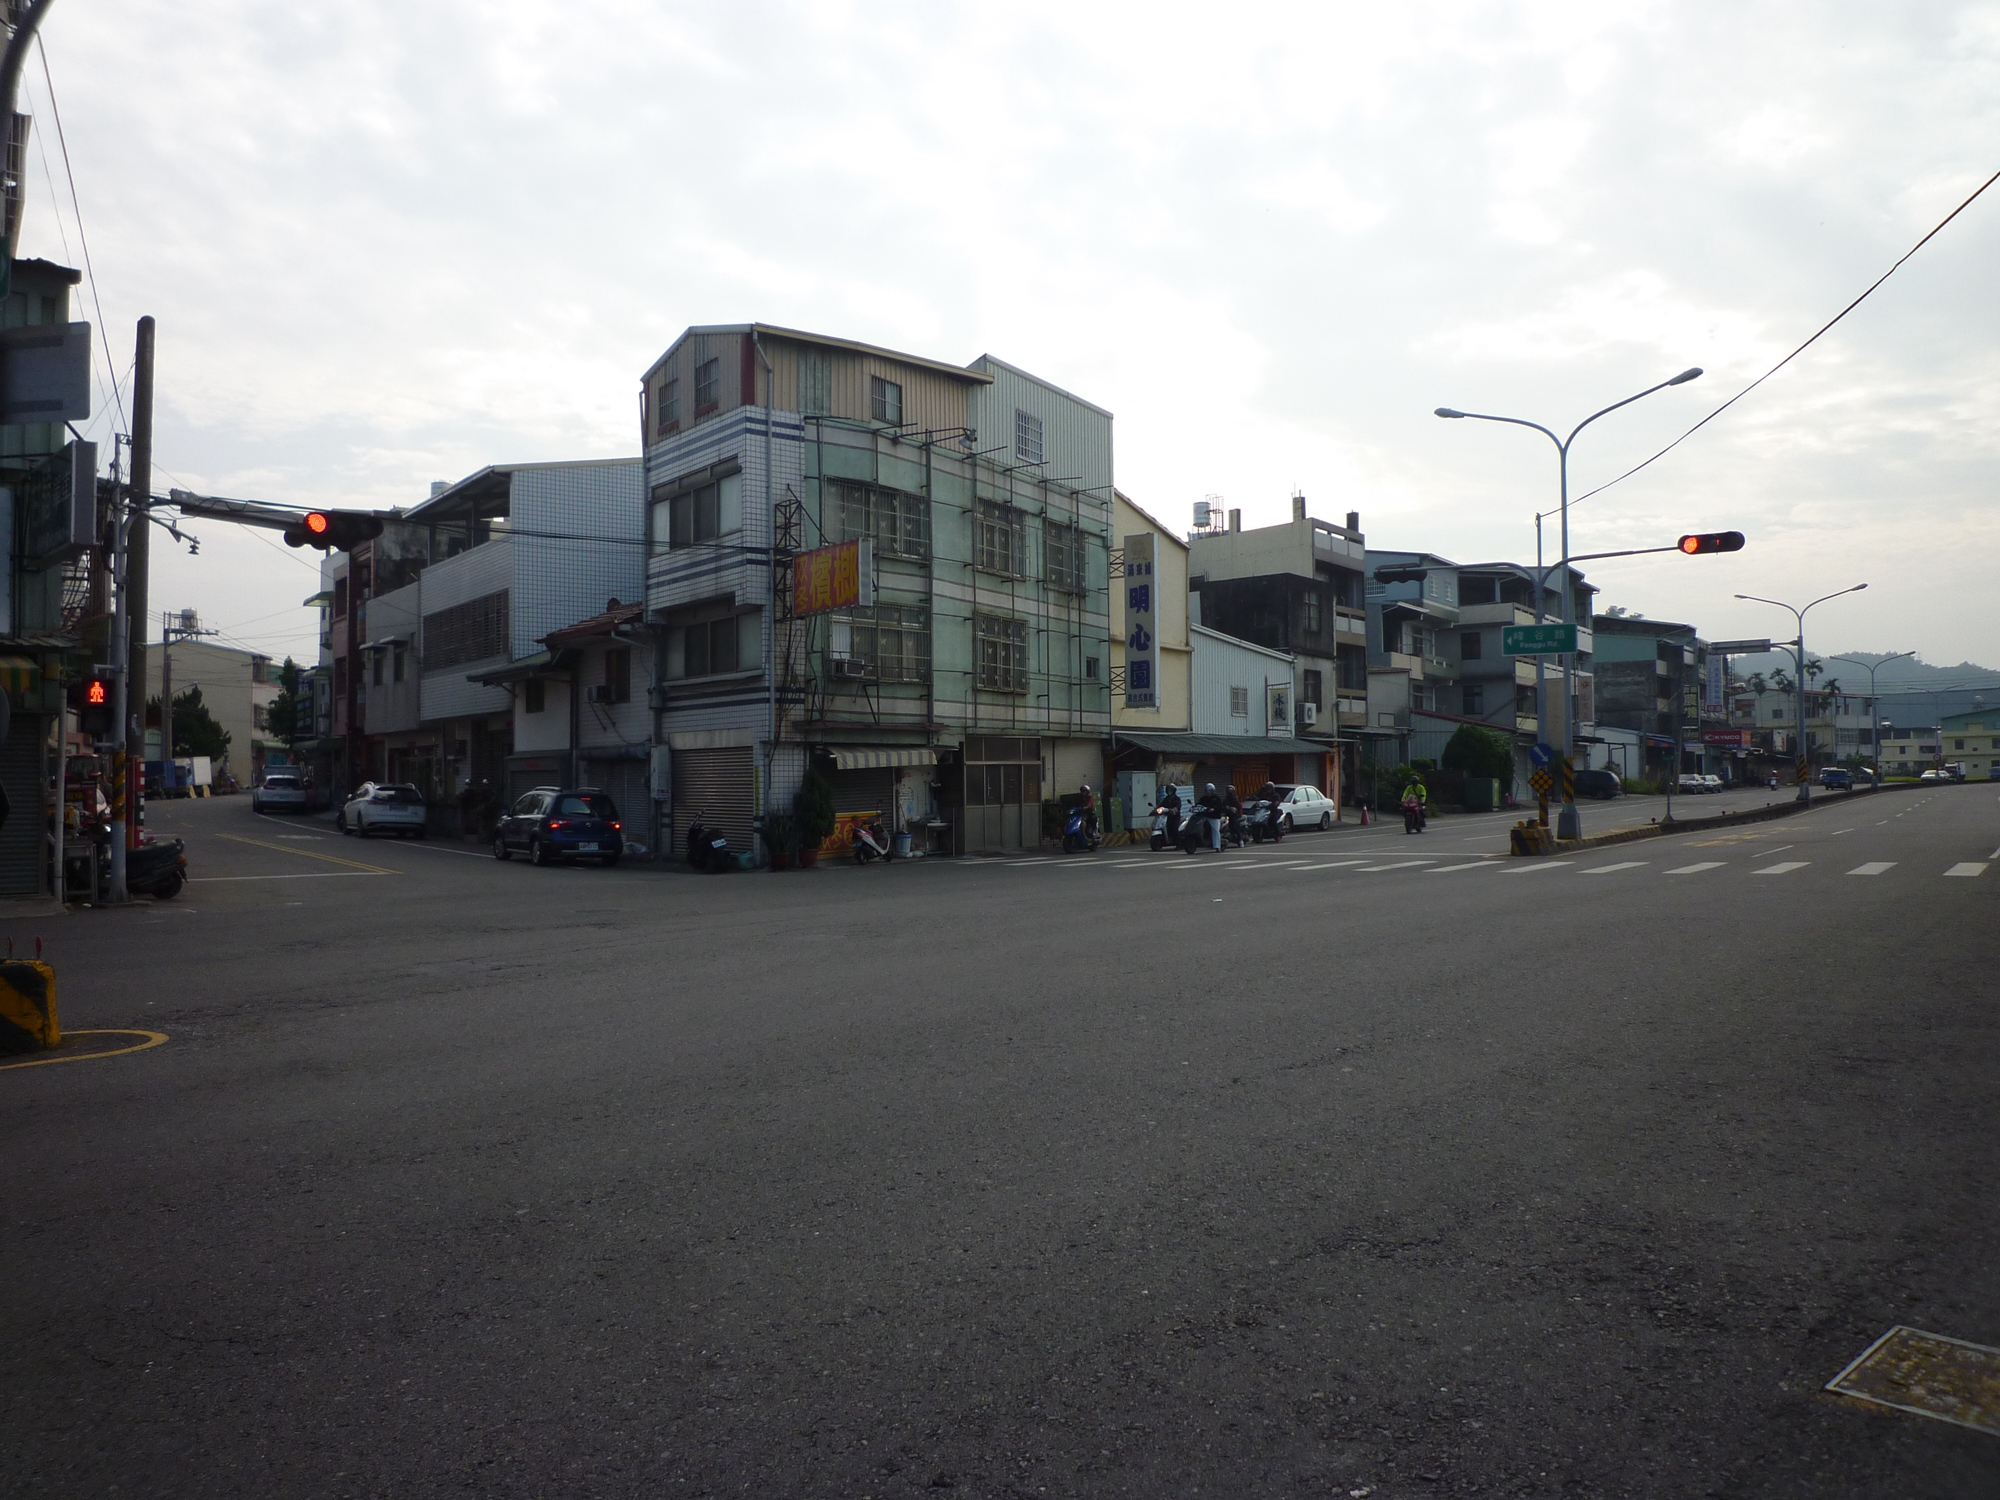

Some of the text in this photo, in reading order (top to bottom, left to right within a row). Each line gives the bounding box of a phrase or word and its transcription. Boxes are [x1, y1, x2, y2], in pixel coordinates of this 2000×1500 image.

[809, 544, 858, 609] 檳榔
[1128, 583, 1151, 690] 明心園
[1513, 629, 1566, 641] 峰谷路
[1519, 641, 1546, 649] Fenggu
